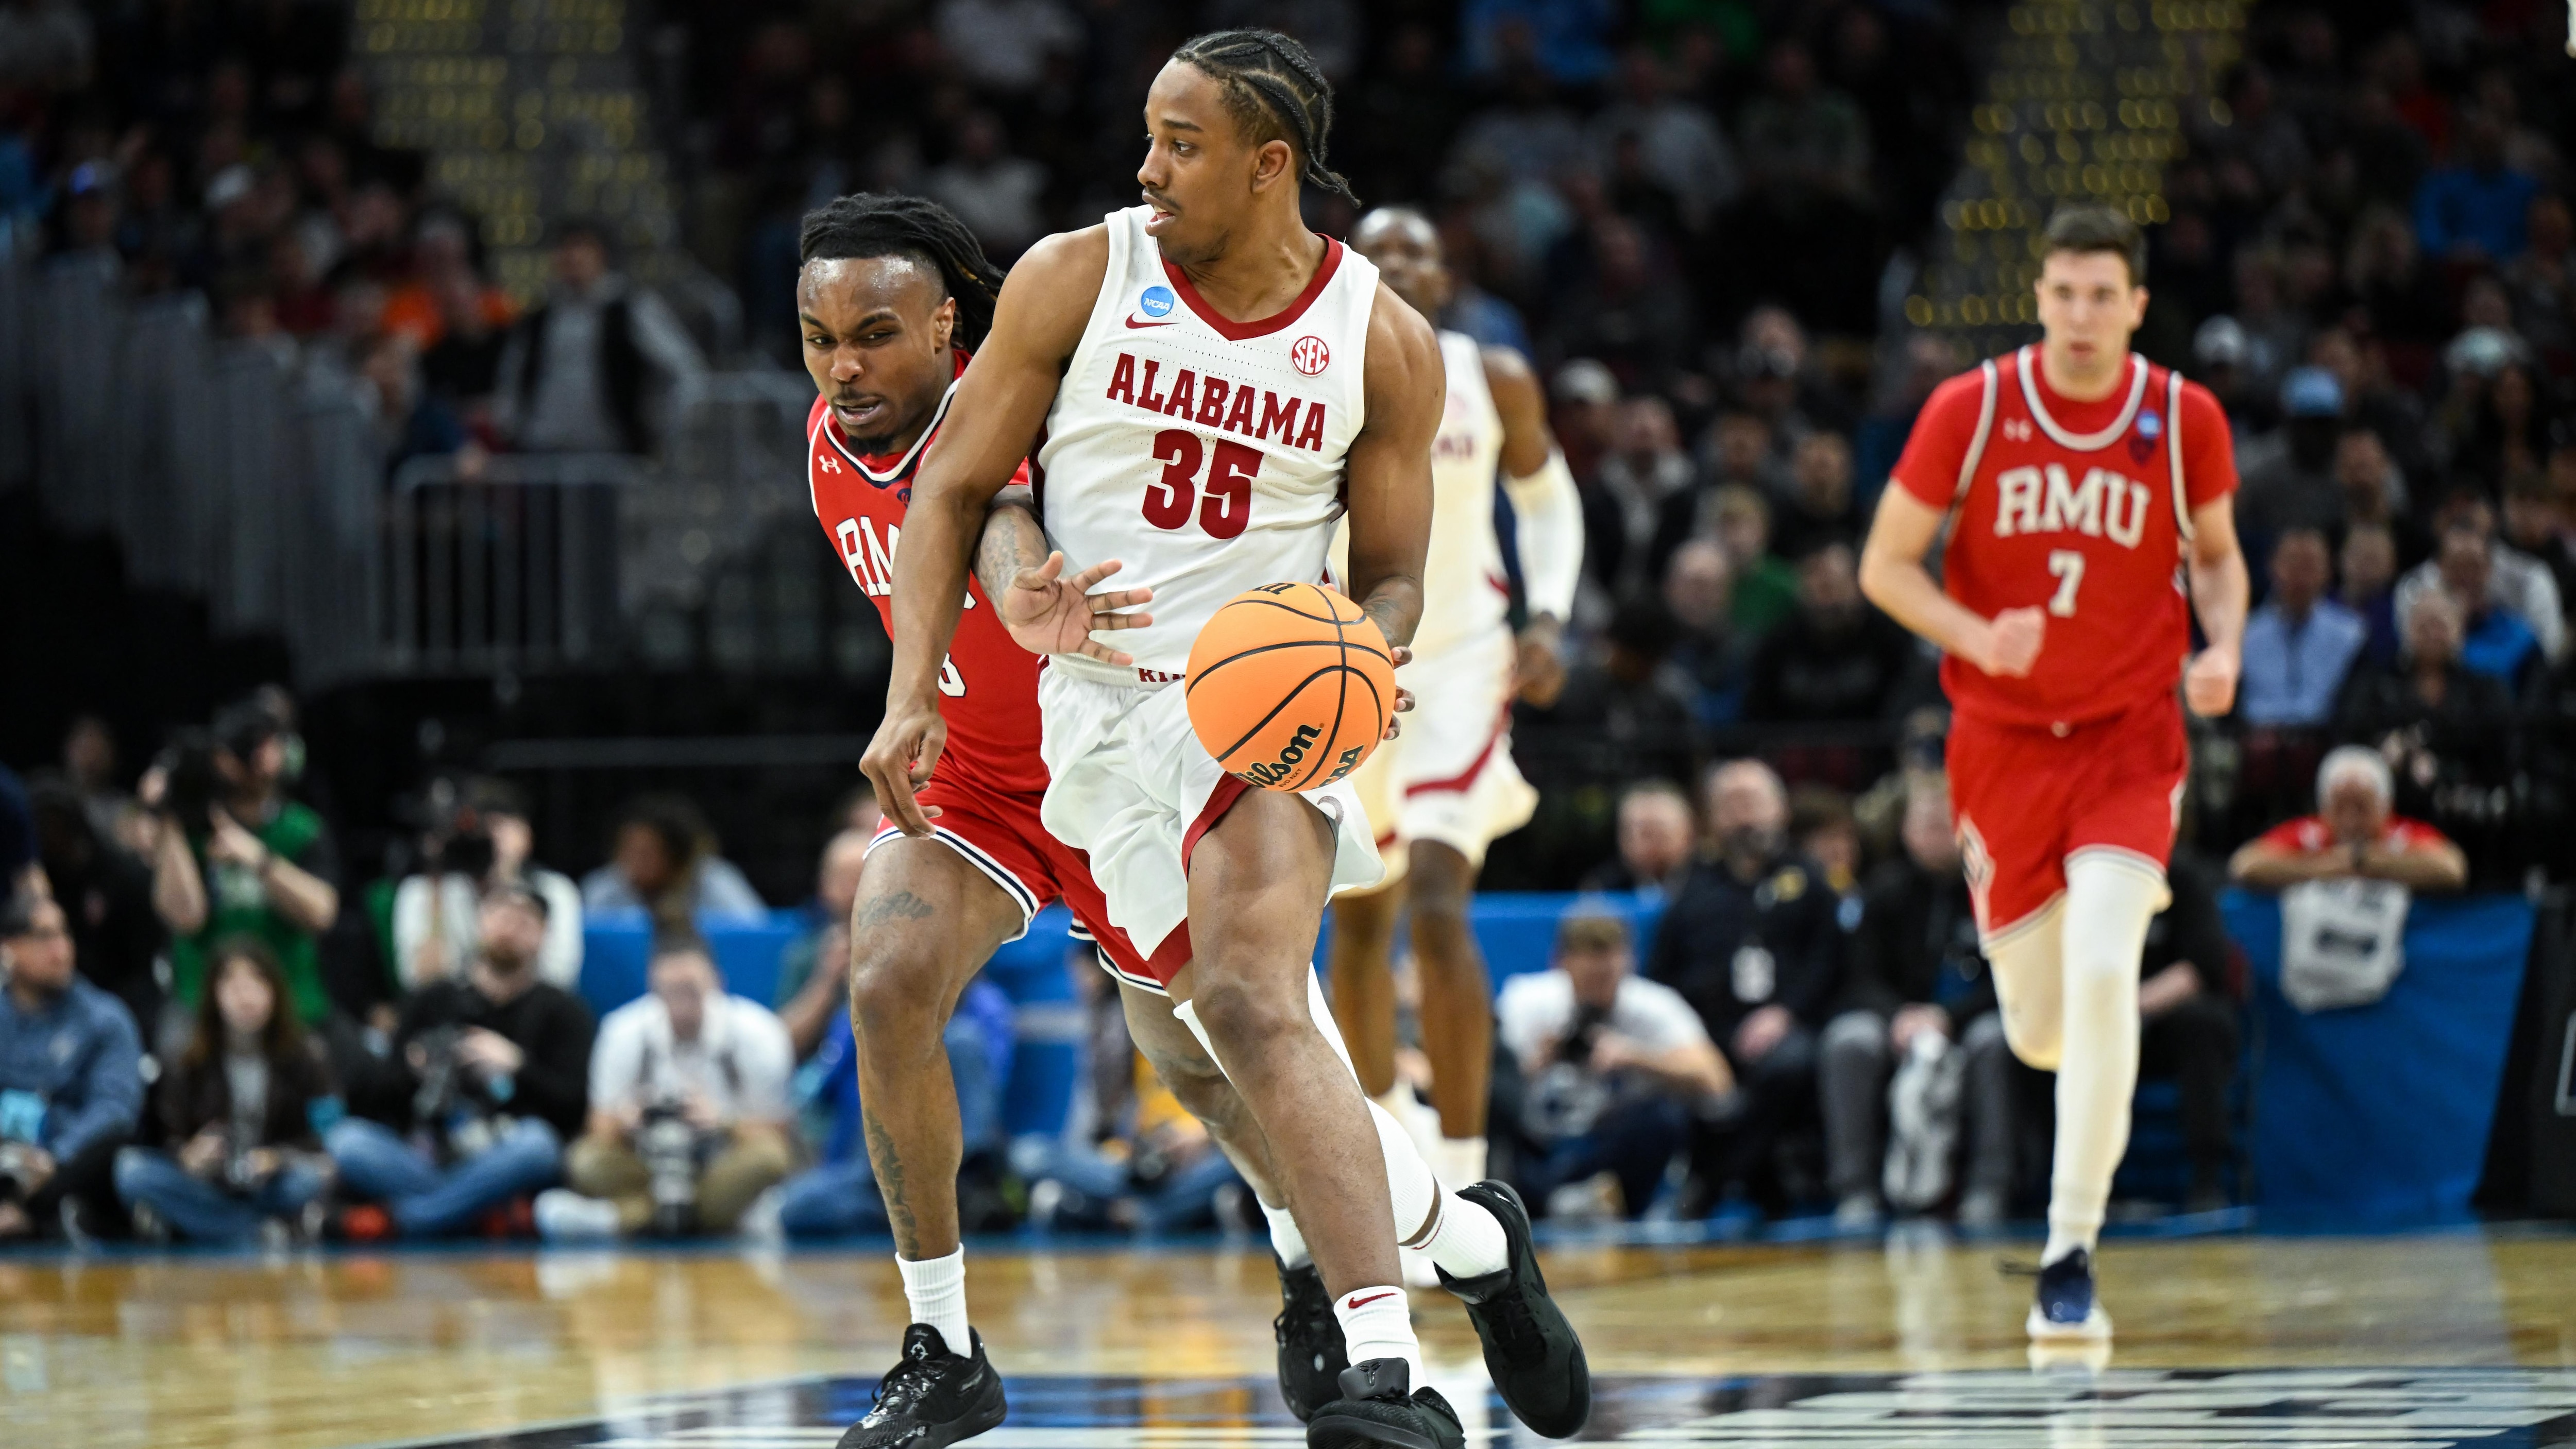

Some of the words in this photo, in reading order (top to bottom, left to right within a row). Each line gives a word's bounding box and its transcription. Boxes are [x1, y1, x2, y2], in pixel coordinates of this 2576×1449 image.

[1144, 298, 1170, 311] NCAA
[1294, 337, 1328, 373] SEC
[1107, 352, 1326, 452] ALABAMA
[1142, 429, 1264, 539] 35
[1993, 464, 2151, 549] RMU
[2048, 549, 2085, 617] 7
